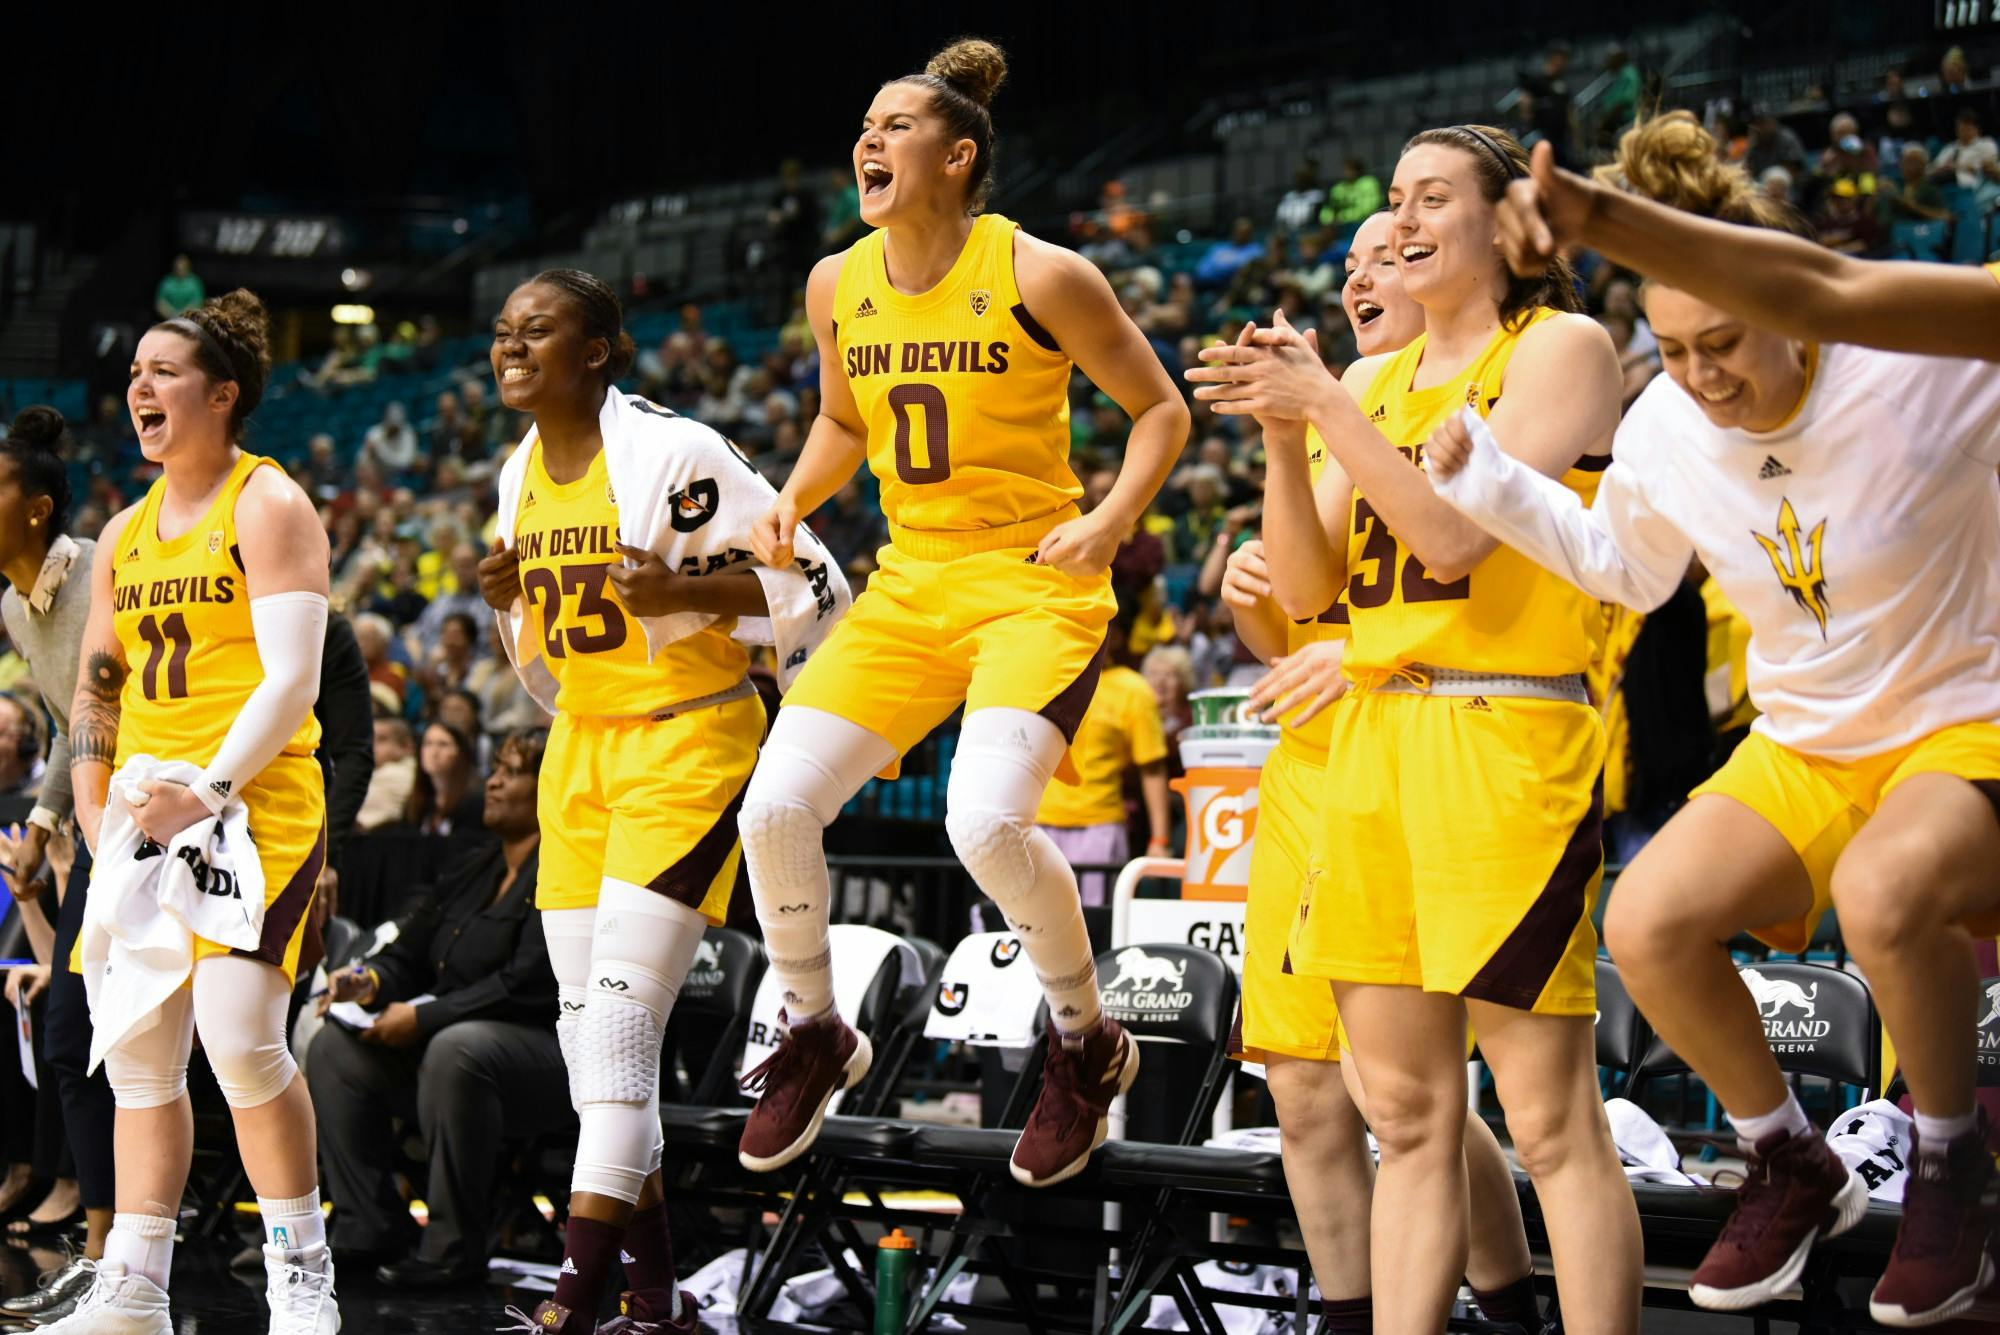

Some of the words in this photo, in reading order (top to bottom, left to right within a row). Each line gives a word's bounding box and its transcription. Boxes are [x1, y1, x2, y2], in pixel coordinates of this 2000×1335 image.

[848, 343, 892, 379] SUN
[901, 341, 1010, 374] DEVILS
[888, 383, 950, 485] 0
[518, 531, 543, 562] UN
[150, 576, 234, 607] DEVILS
[524, 563, 627, 659] 23
[138, 613, 192, 701] 11
[1204, 796, 1244, 850] G
[1188, 921, 1244, 956] GA
[1100, 990, 1130, 1007] GM
[1132, 992, 1193, 1009] GRAND
[1142, 1013, 1179, 1023] ARENA
[1769, 1043, 1815, 1053] ARENA
